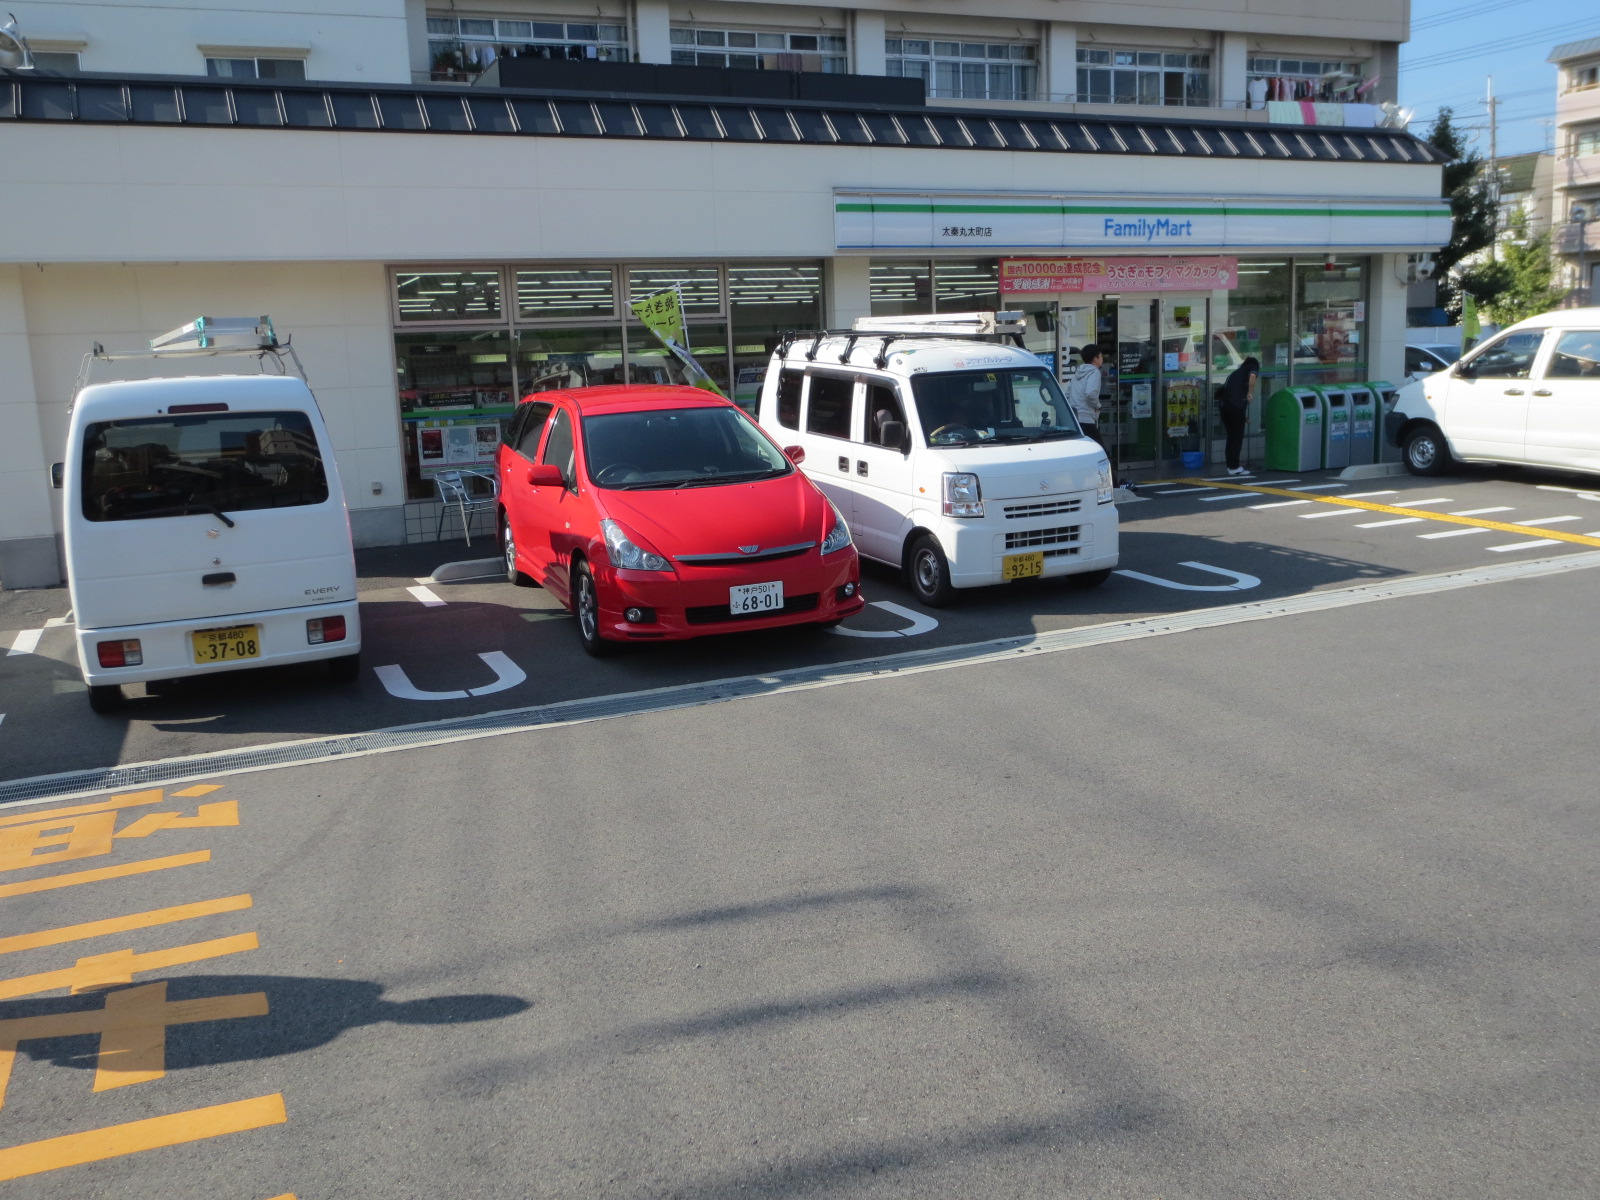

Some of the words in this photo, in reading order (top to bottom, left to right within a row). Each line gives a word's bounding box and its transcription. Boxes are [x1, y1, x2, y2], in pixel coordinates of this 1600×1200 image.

[942, 226, 993, 238] 太秦丸太町店
[1104, 218, 1192, 240] FamilyMart
[1011, 561, 1042, 577] 92-15
[304, 585, 340, 596] EVERY
[742, 585, 771, 595] 神戸501
[742, 593, 779, 611] 68-01
[208, 630, 244, 642] 京都480
[208, 639, 257, 660] 37-08
